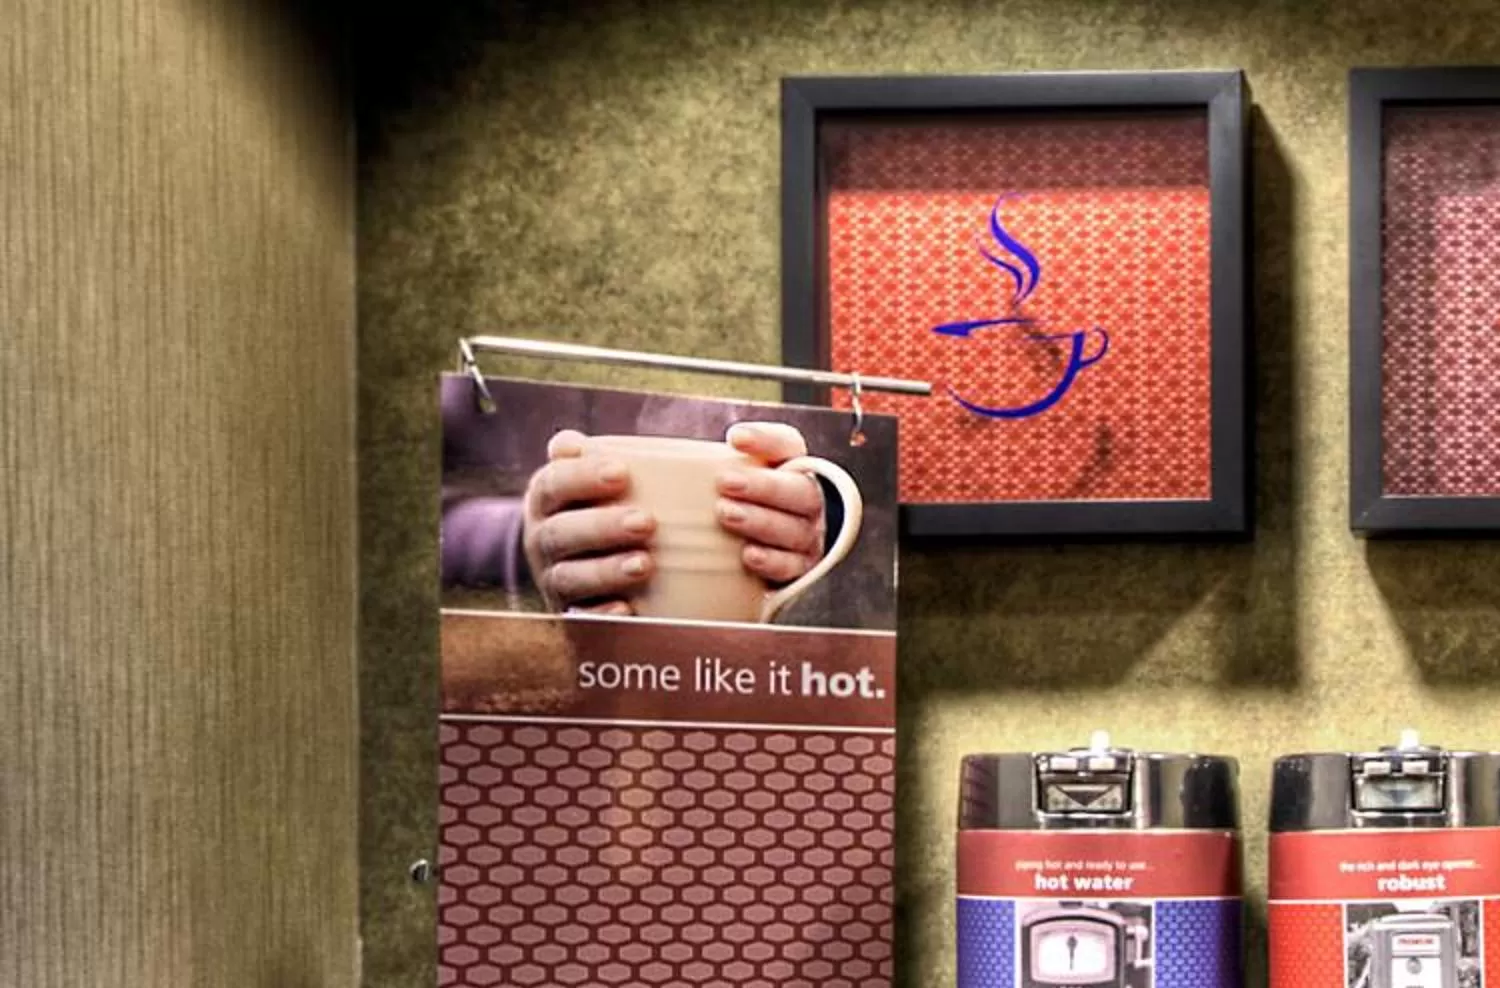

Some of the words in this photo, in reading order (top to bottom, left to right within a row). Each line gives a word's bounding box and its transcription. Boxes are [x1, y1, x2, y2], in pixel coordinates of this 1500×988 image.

[578, 660, 681, 692] some
[694, 657, 755, 695] like
[768, 662, 791, 696] it
[800, 661, 887, 698] hot.
[1045, 859, 1062, 869] hot
[1064, 860, 1084, 869] and
[1085, 860, 1112, 871] ready
[1115, 860, 1126, 869] to
[1377, 860, 1396, 870] and
[1398, 859, 1420, 870] dark
[1034, 873, 1068, 890] hot
[1073, 874, 1134, 890] water
[1377, 872, 1446, 891] robust
